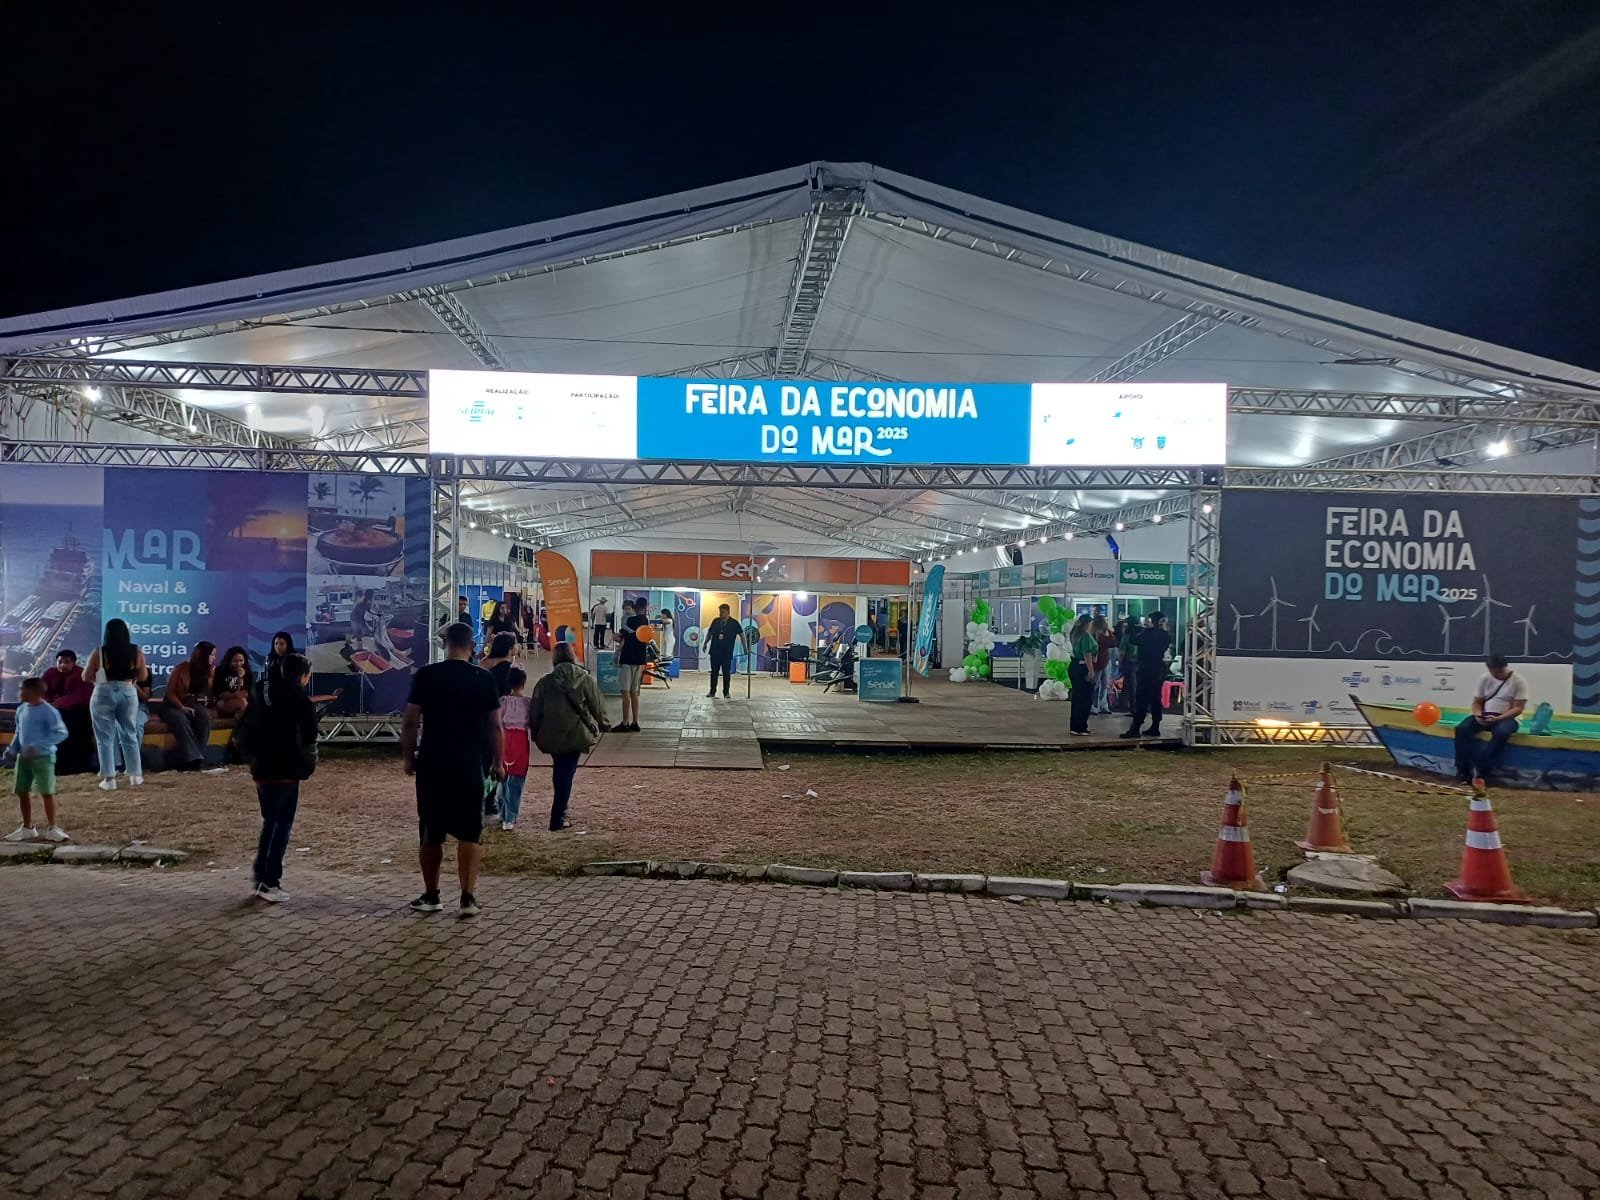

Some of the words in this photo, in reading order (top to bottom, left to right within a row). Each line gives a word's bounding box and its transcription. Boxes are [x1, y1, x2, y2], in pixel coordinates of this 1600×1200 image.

[685, 383, 768, 416] FEIRA
[781, 386, 821, 417] DA
[830, 387, 978, 419] ECONOMIA
[761, 424, 799, 455] DO
[811, 426, 893, 457] MAR
[876, 426, 909, 441] 2025
[1325, 506, 1410, 537] FEIRA
[1422, 509, 1465, 539] DA
[102, 527, 206, 572] MAR
[1324, 539, 1477, 571] ECONOMIA
[117, 579, 169, 594] Naval
[173, 581, 187, 594] &
[1139, 573, 1166, 581] TODOS
[1324, 571, 1363, 601] DO
[1376, 573, 1460, 604] MAR
[1439, 587, 1478, 601] 2025
[117, 599, 192, 615] Turismo
[196, 601, 210, 615] &
[127, 621, 172, 635] esca
[176, 621, 190, 635] &
[141, 641, 188, 658] ergia
